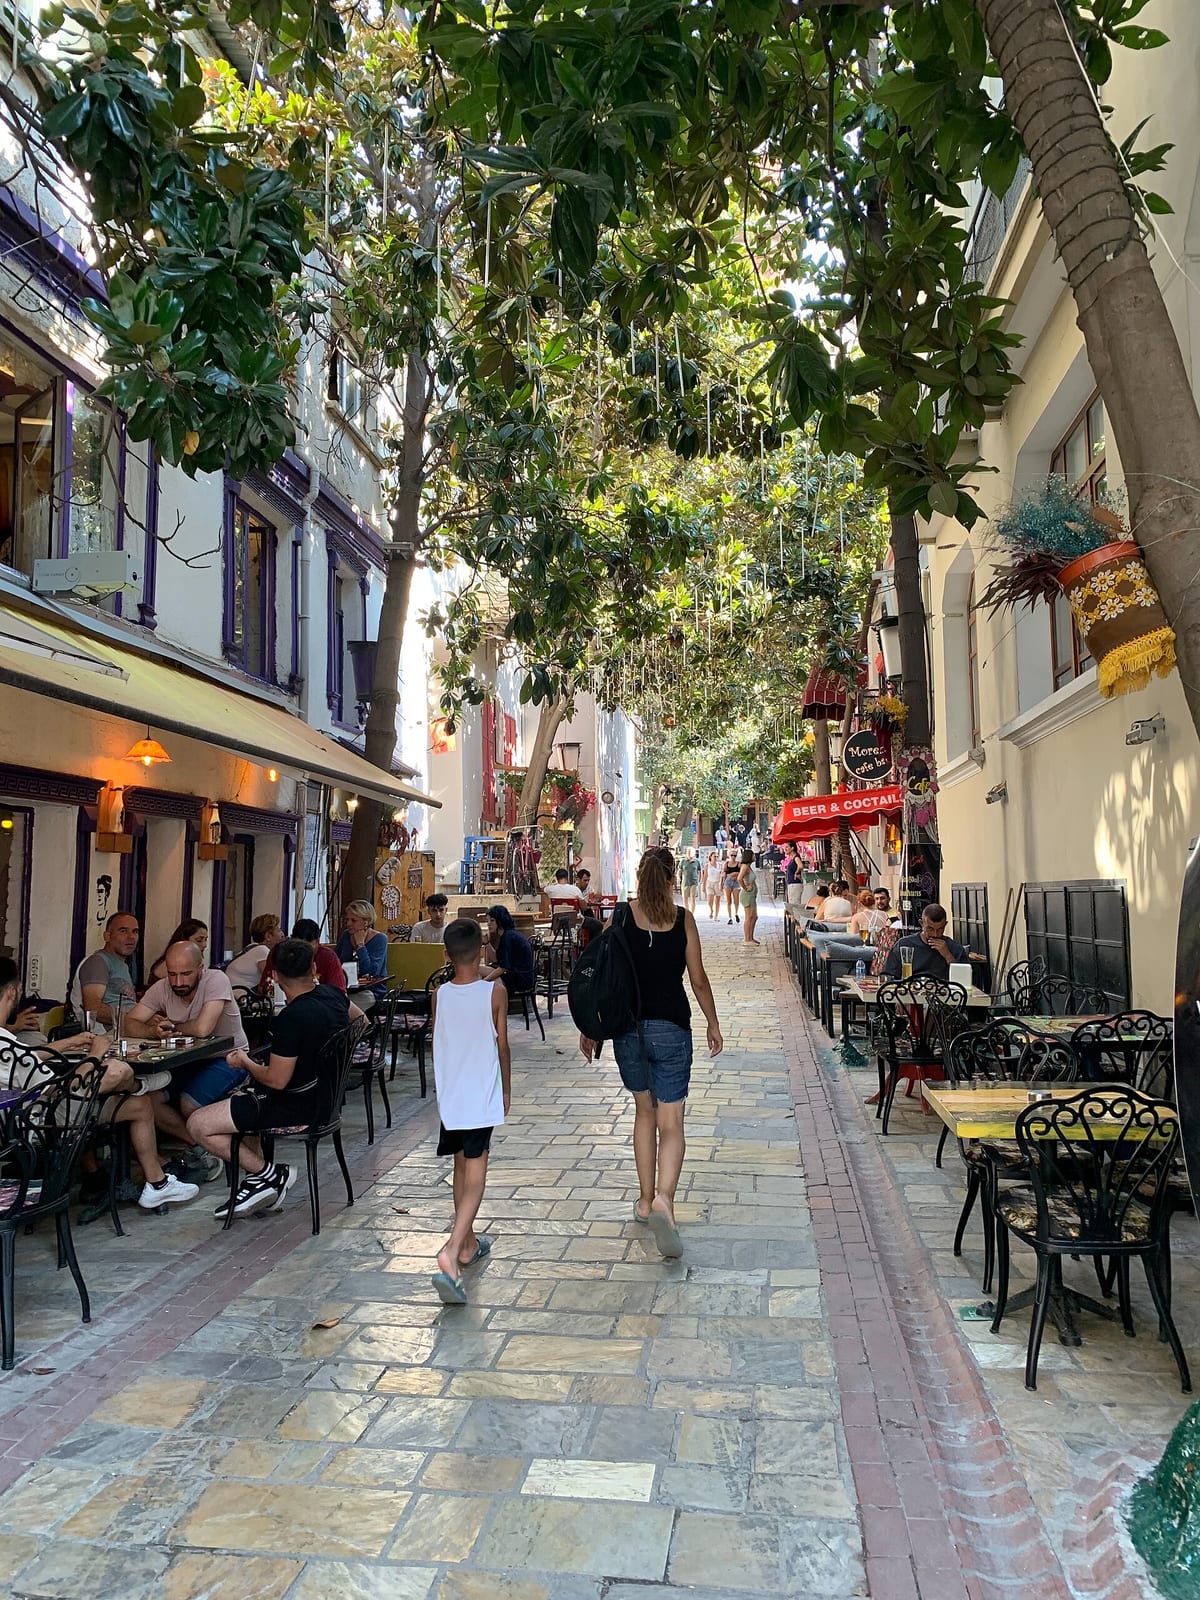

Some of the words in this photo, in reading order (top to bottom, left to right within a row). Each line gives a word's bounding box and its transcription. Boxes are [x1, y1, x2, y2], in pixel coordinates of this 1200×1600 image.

[855, 761, 874, 775] cafe
[907, 775, 930, 796] Cafe
[793, 804, 827, 817] BEER
[830, 802, 840, 813] &
